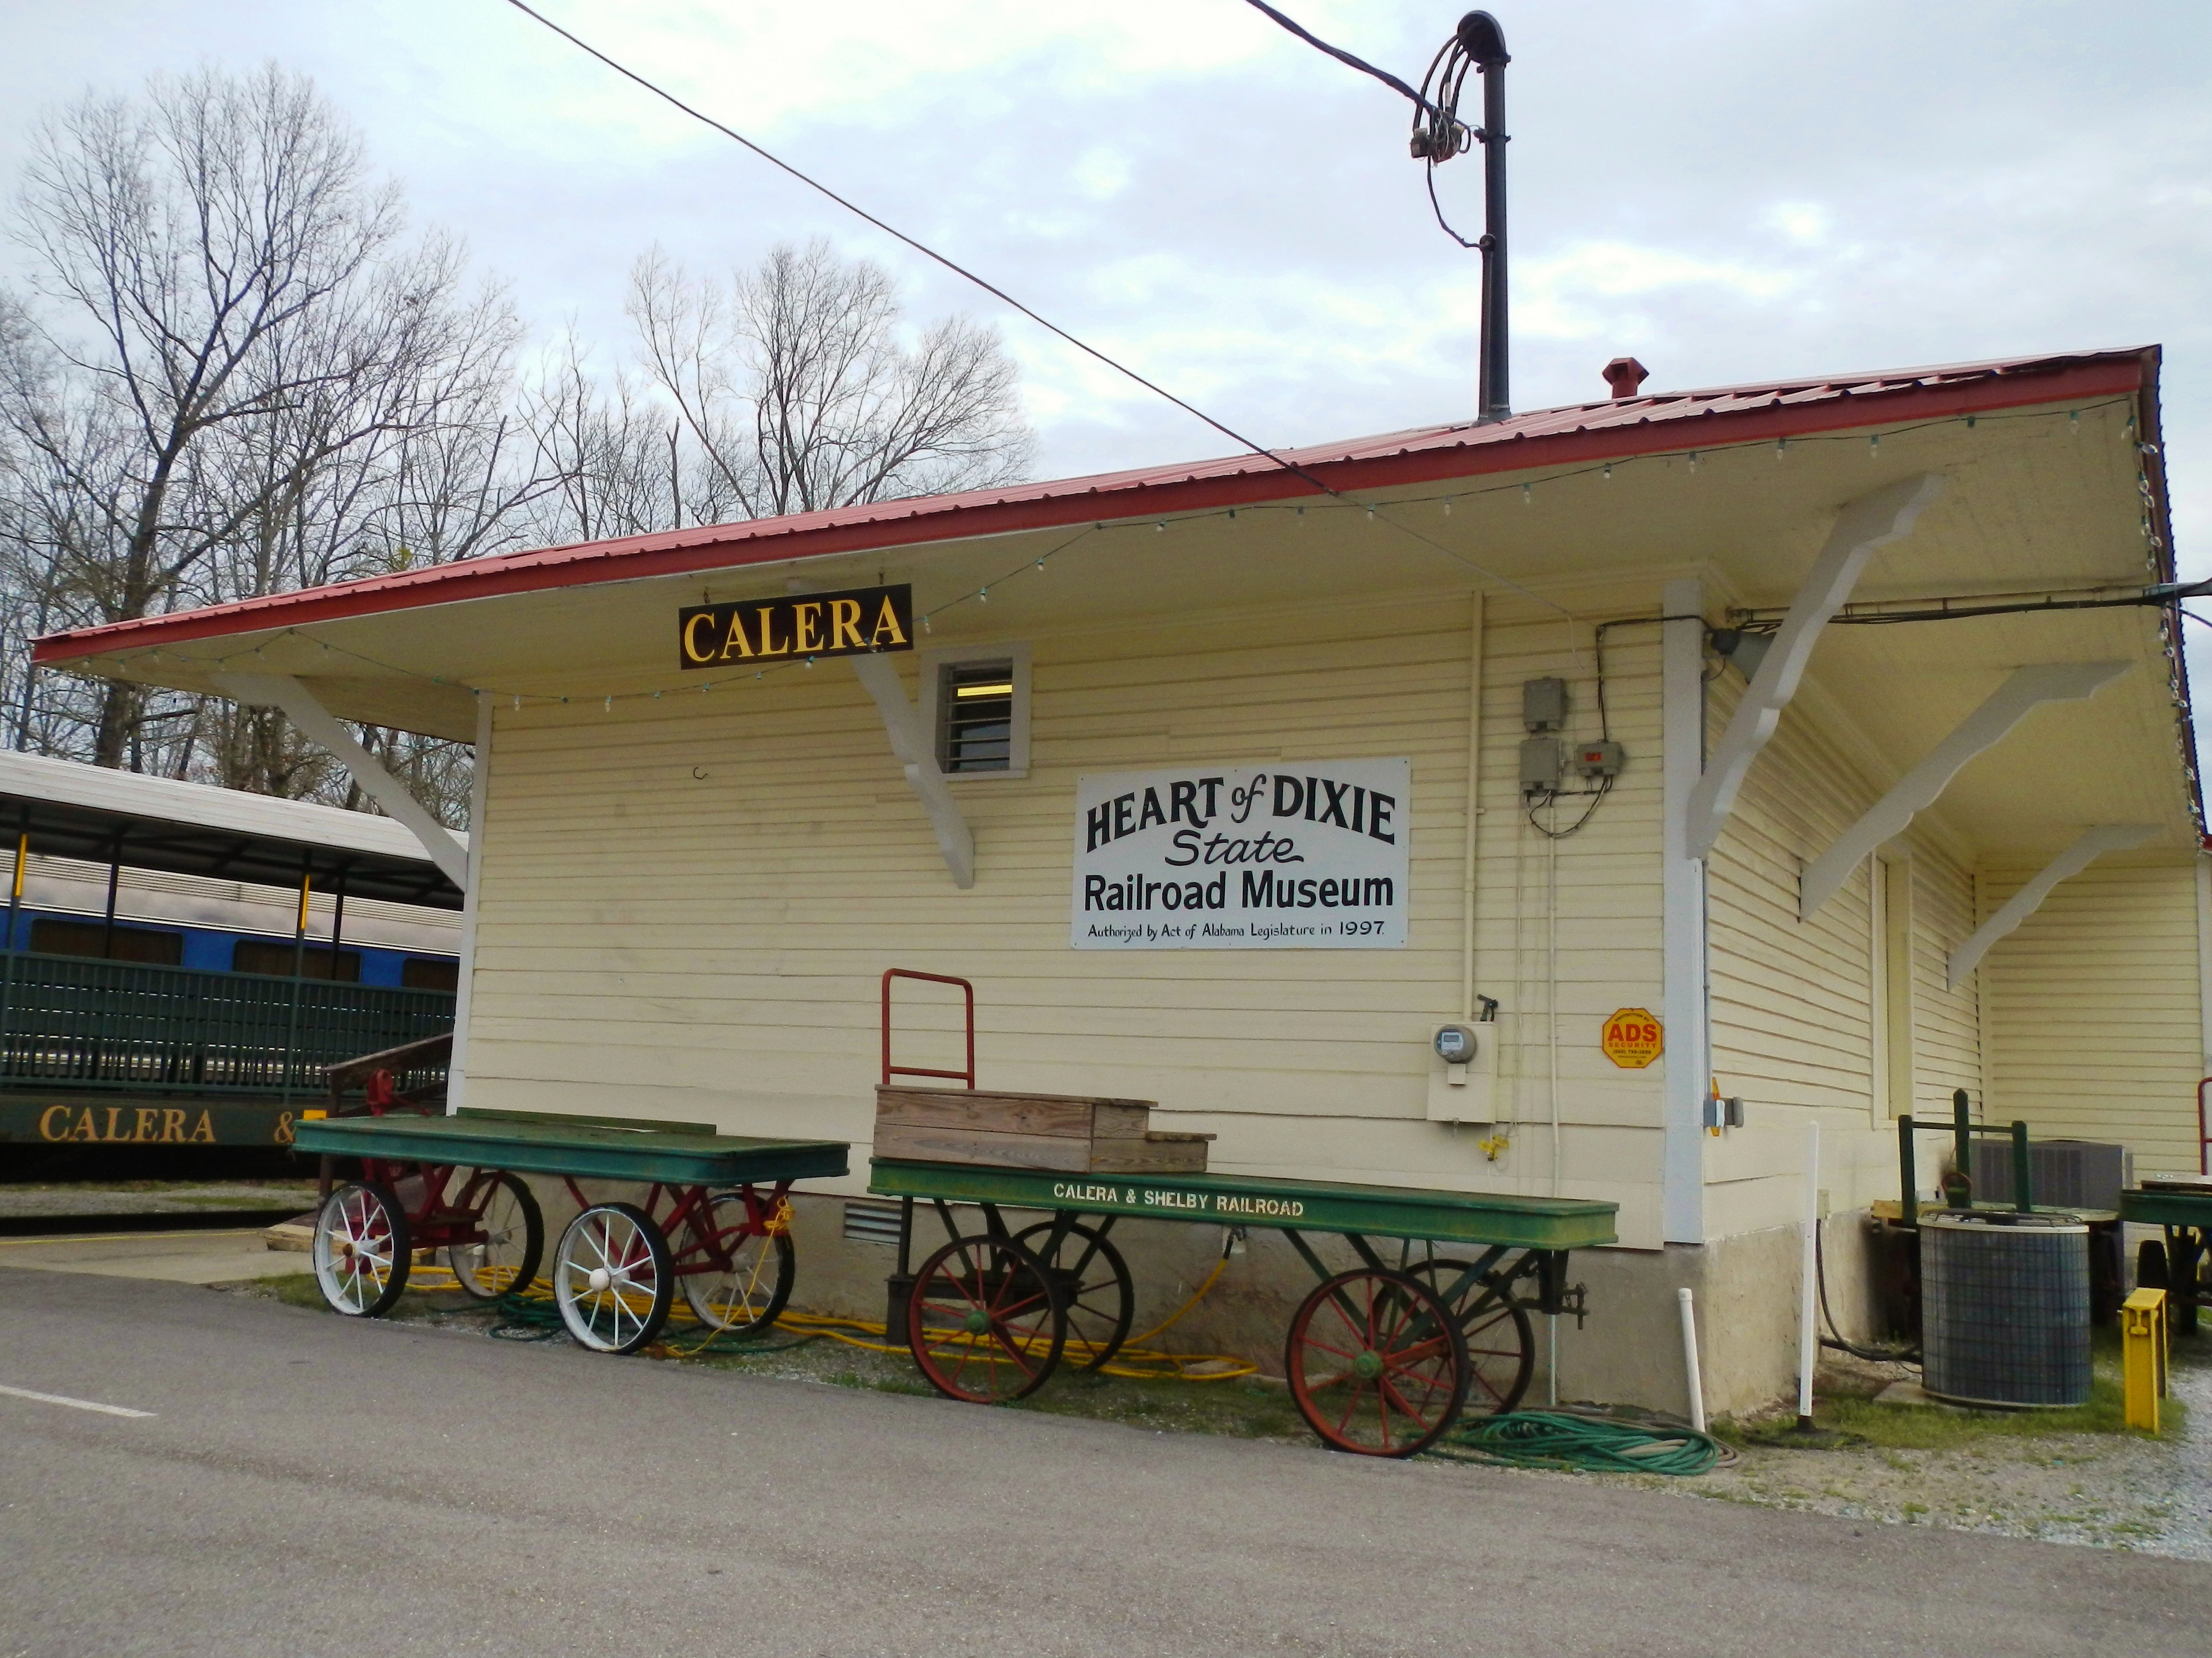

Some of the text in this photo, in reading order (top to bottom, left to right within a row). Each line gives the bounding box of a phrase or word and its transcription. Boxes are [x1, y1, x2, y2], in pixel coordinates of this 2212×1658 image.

[685, 595, 908, 663] CALERA
[1087, 773, 1396, 853] HEART of DIXIE
[1164, 829, 1304, 867] State
[1085, 869, 1393, 911] Railroad Museum
[1088, 924, 1142, 943] Authorized
[1146, 927, 1158, 941] by
[1161, 926, 1181, 937] Act
[1185, 923, 1198, 940] of
[1201, 922, 1245, 937] Alabama
[1250, 922, 1315, 941] Legislature
[1321, 923, 1332, 935] in
[1607, 1023, 1658, 1043] ADS
[39, 1104, 297, 1144] CALERA &
[1053, 1183, 1304, 1217] CALERA & SHELBY RAILROAD
